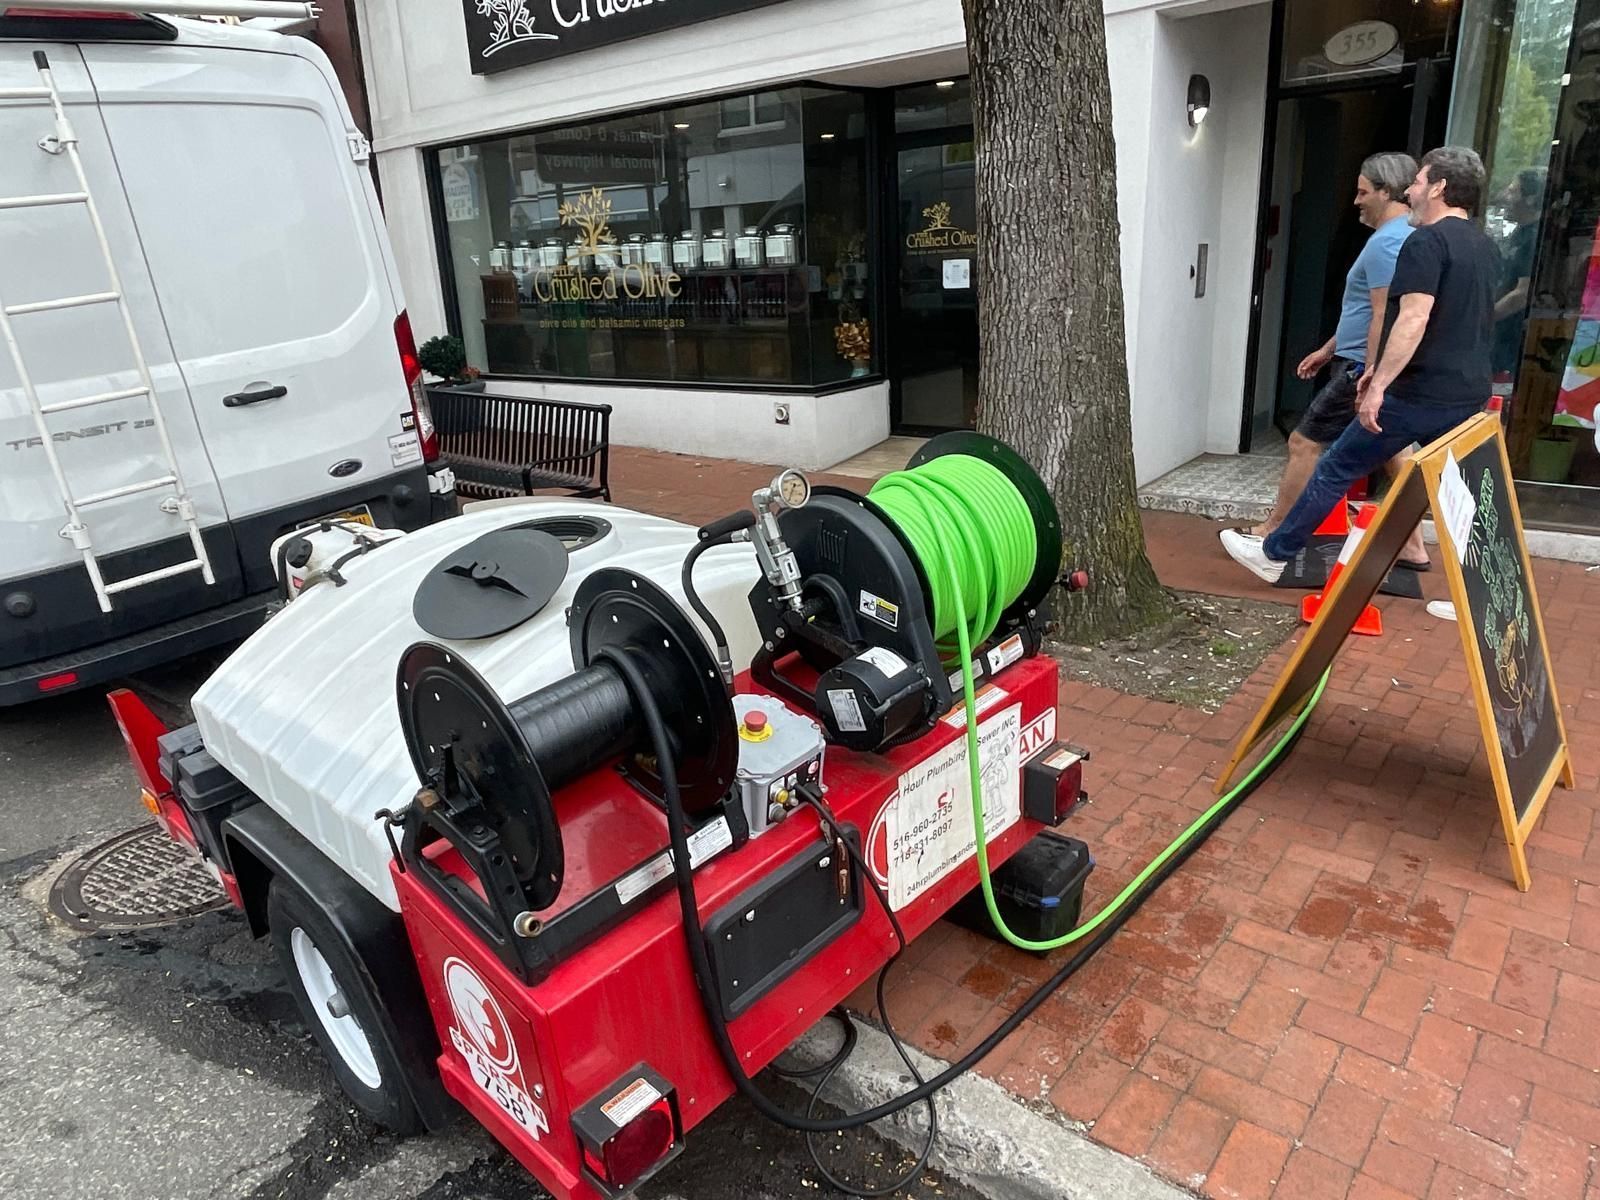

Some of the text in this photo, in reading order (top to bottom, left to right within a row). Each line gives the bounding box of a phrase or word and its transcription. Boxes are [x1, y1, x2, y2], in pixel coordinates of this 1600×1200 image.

[1340, 31, 1378, 55] 355
[906, 231, 949, 248] Crushed
[535, 262, 682, 302] Crushed Olive
[580, 318, 596, 328] and
[599, 317, 640, 328] balsamic
[643, 317, 685, 330] vinegars
[903, 776, 925, 796] Hour
[926, 749, 967, 782] Plumbing
[977, 725, 1002, 747] Sewer
[893, 801, 953, 851] 516-960-2735
[451, 1030, 546, 1126] SPARTAN
[478, 1067, 527, 1125] 758
